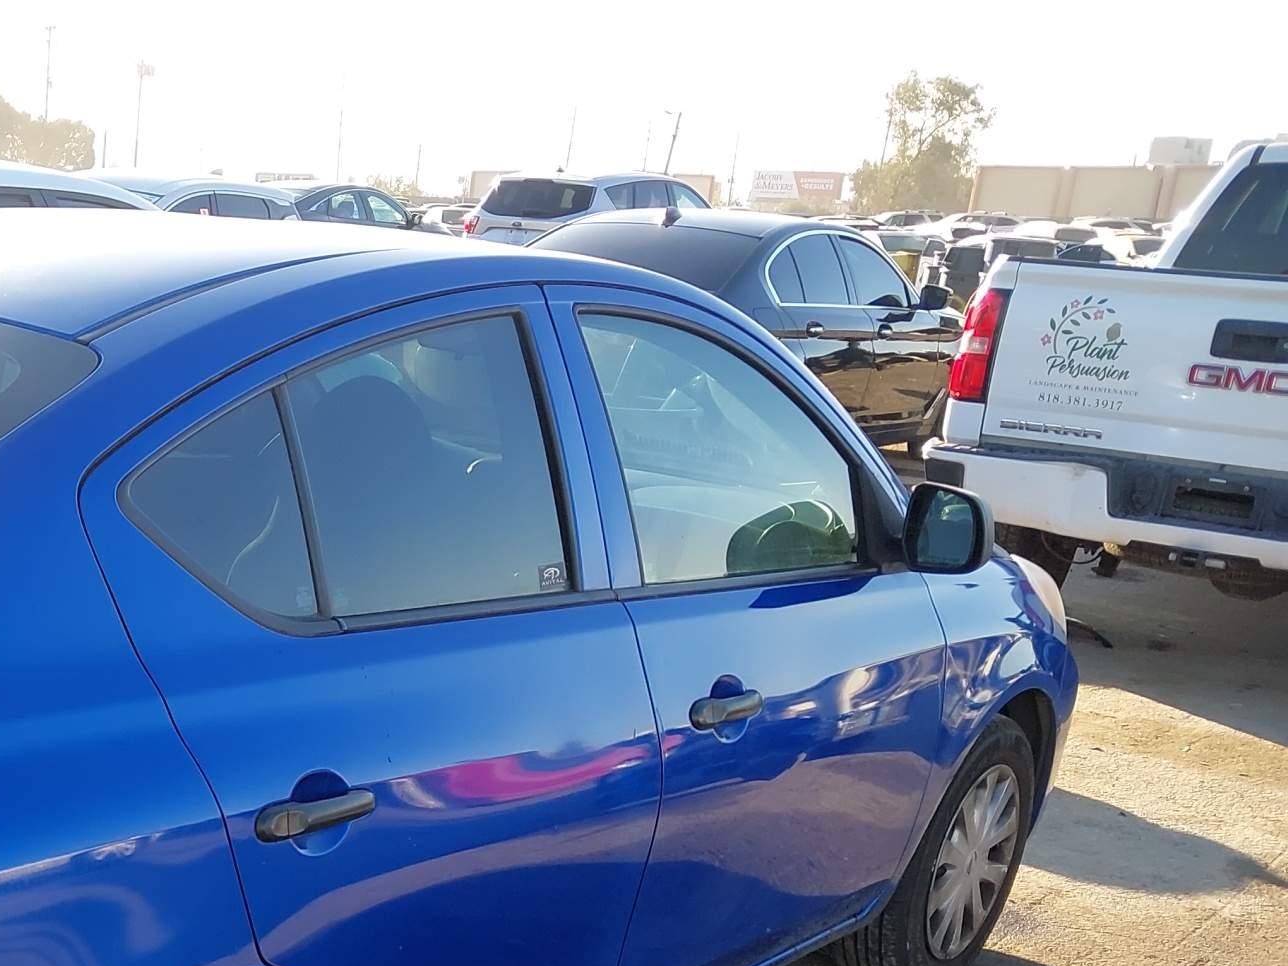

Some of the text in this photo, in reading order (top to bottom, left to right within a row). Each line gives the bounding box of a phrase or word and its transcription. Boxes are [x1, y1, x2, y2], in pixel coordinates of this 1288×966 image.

[1066, 336, 1128, 360] Plant
[1046, 355, 1130, 380] Persuasion
[1028, 380, 1072, 390] LANDSCAPE
[1083, 385, 1139, 397] MAINTENANCE
[1038, 392, 1123, 411] 818.381.3917
[999, 418, 1103, 439] SIERRA
